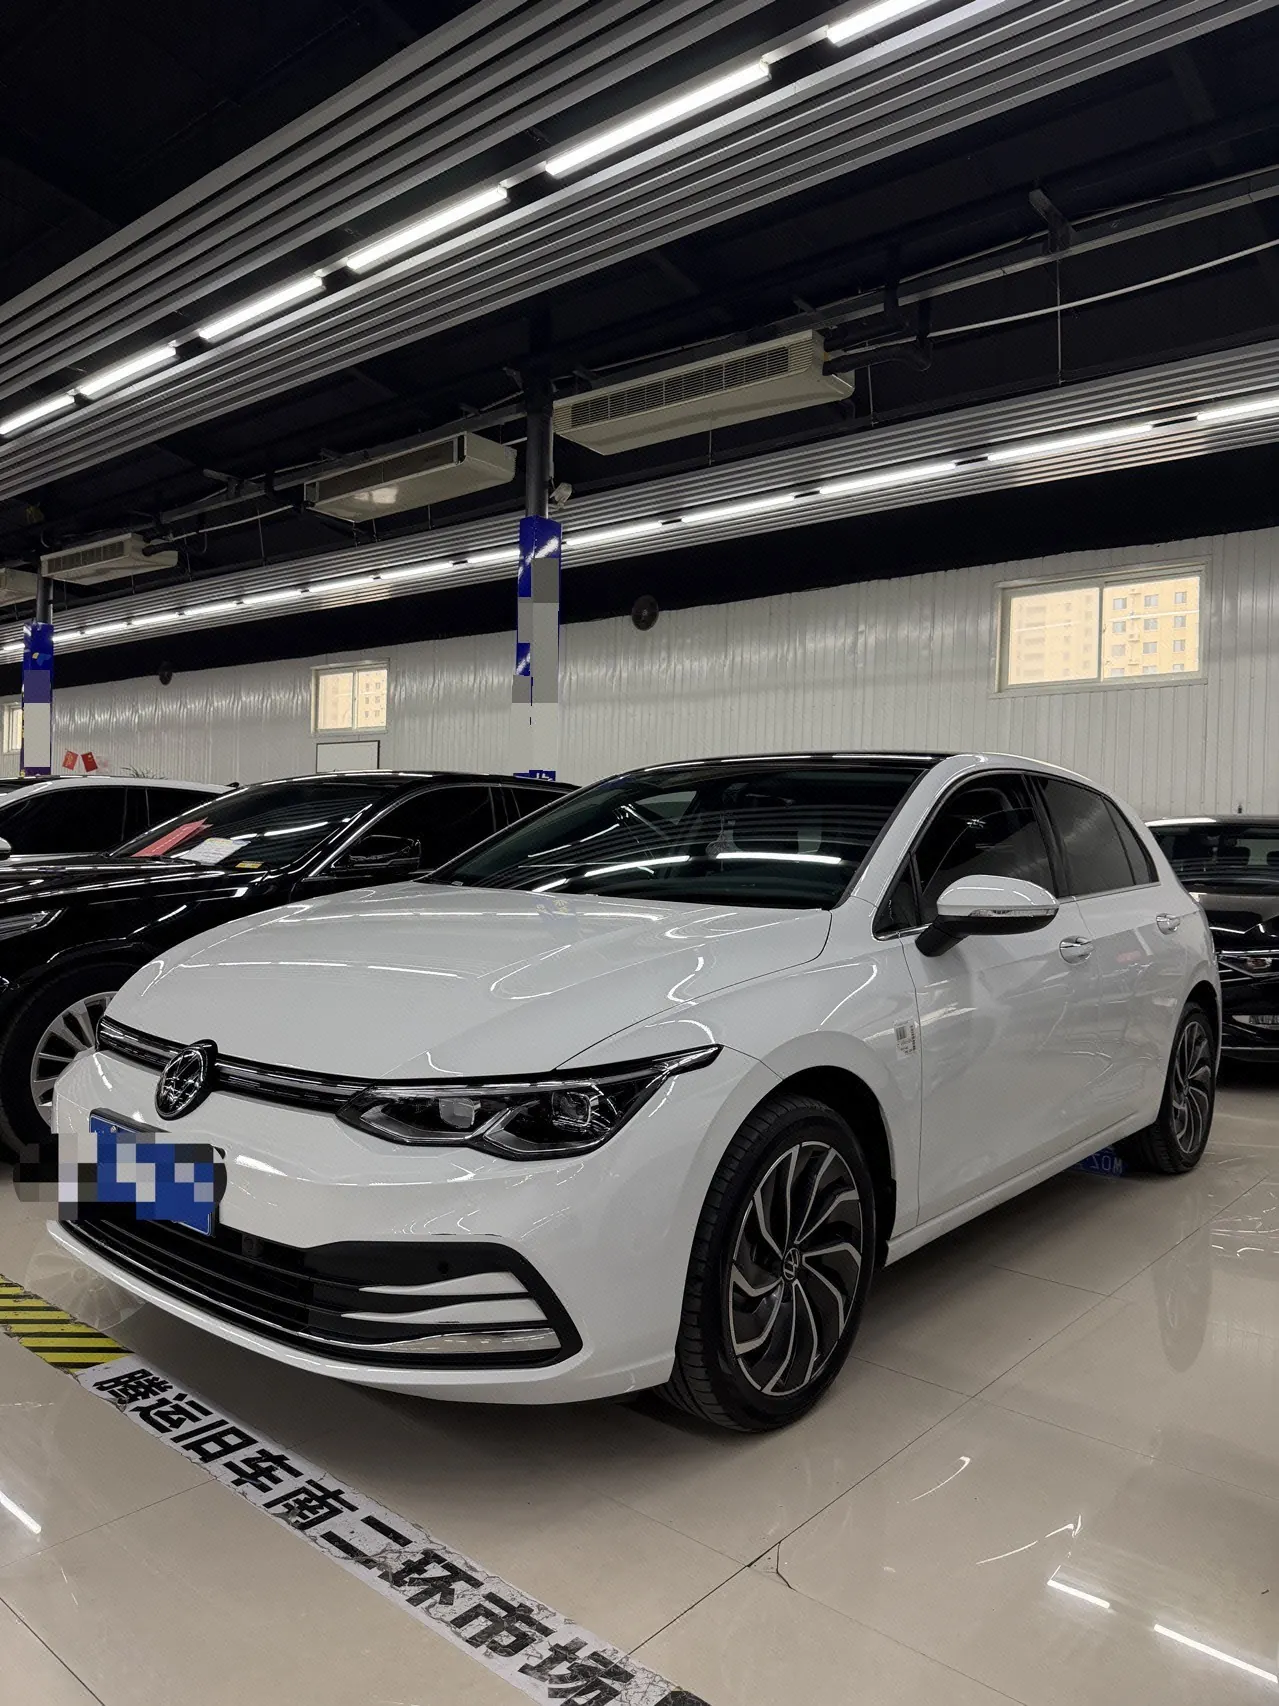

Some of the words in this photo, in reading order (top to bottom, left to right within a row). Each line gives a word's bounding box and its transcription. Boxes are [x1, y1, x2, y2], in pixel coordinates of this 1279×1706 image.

[92, 1368, 635, 1706] 腾运旧车南二环市场
